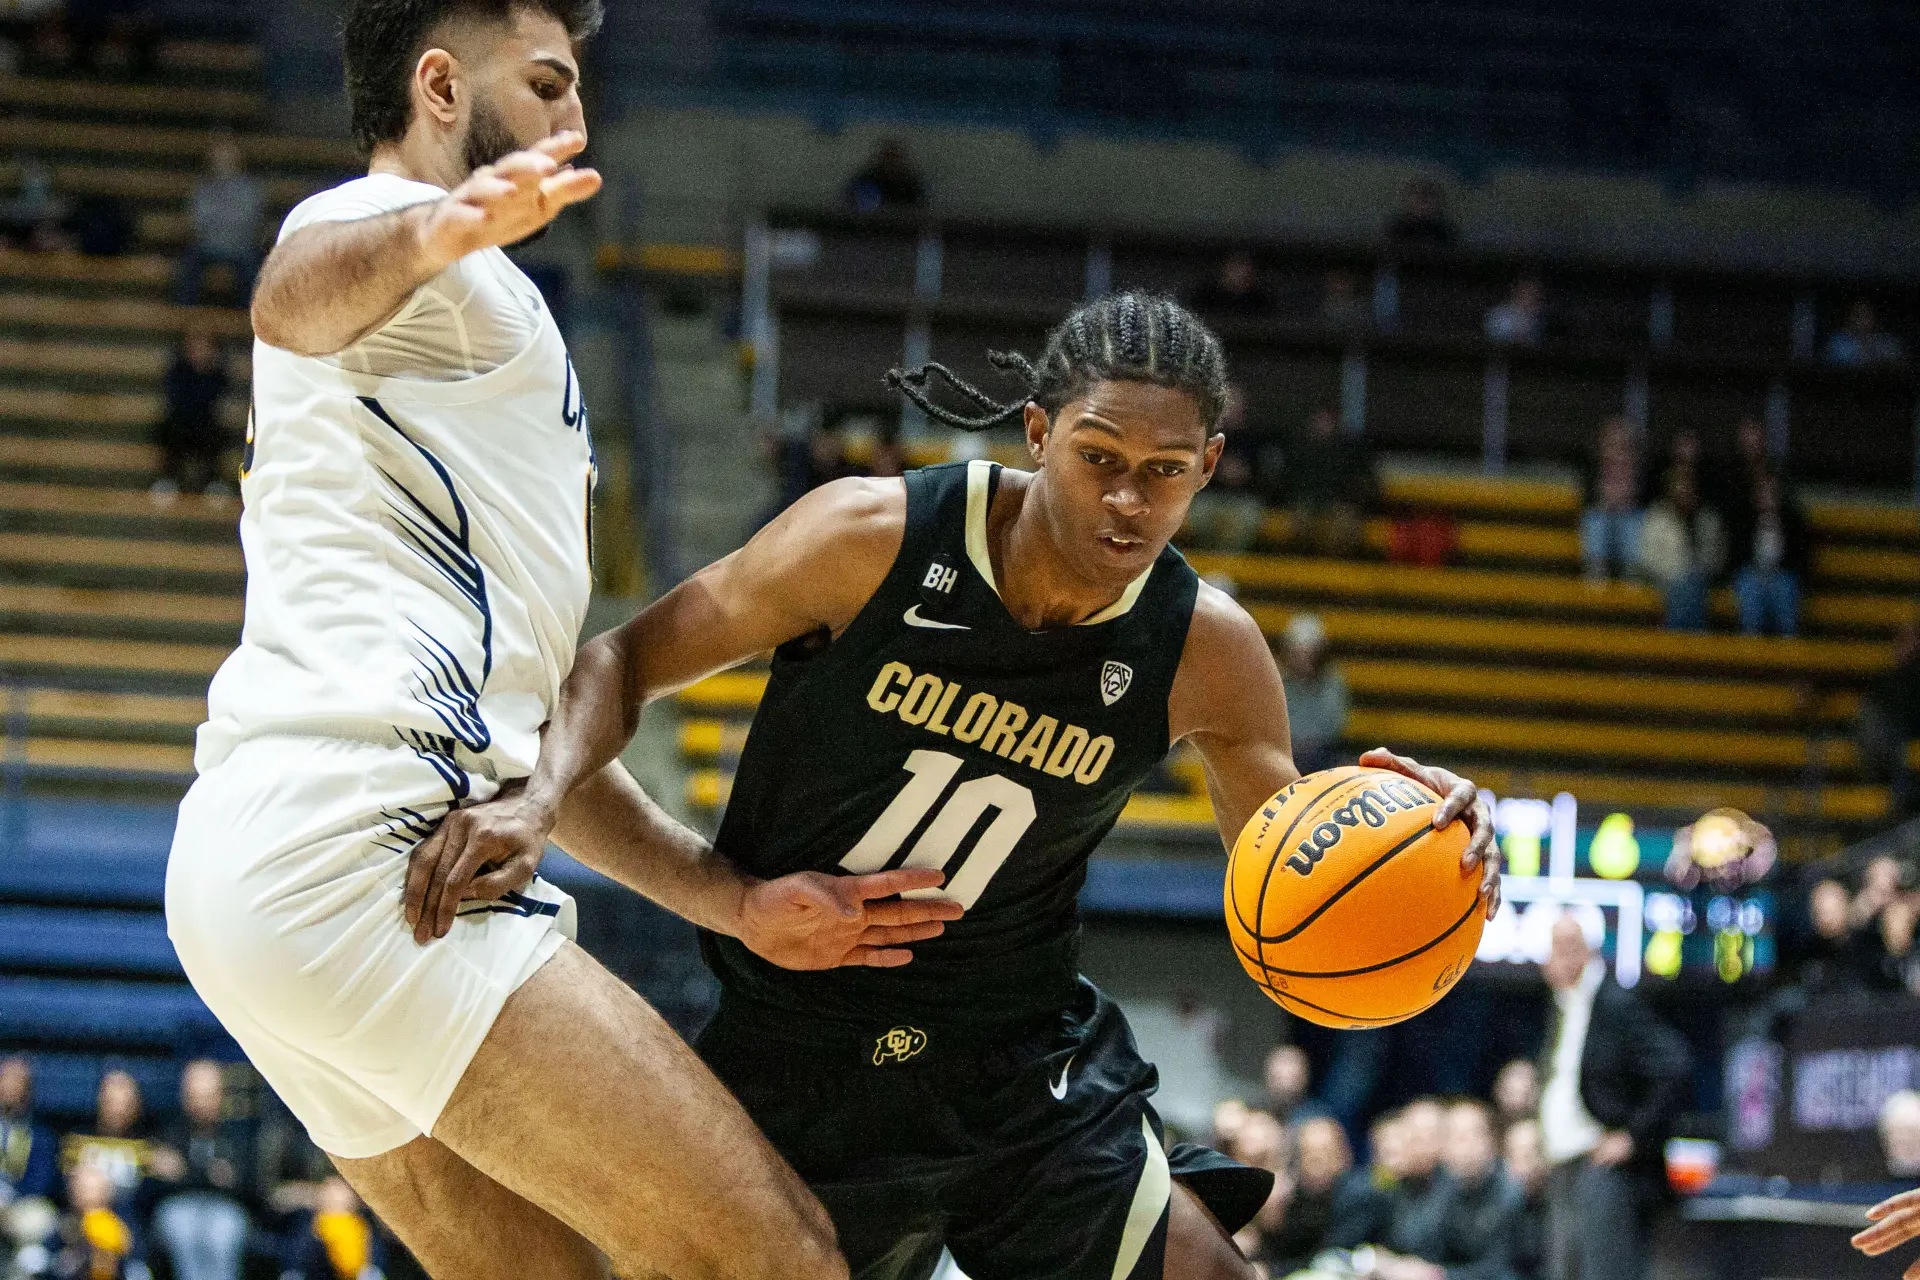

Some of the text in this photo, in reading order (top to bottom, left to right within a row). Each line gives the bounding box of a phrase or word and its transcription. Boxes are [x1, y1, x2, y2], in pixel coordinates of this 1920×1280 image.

[922, 562, 958, 594] BH
[1103, 663, 1131, 691] PAC
[1104, 680, 1120, 697] 12
[866, 661, 1115, 785] COLORADO
[838, 749, 1037, 912] 10
[1285, 777, 1437, 877] Wilson
[887, 1029, 912, 1053] CU
